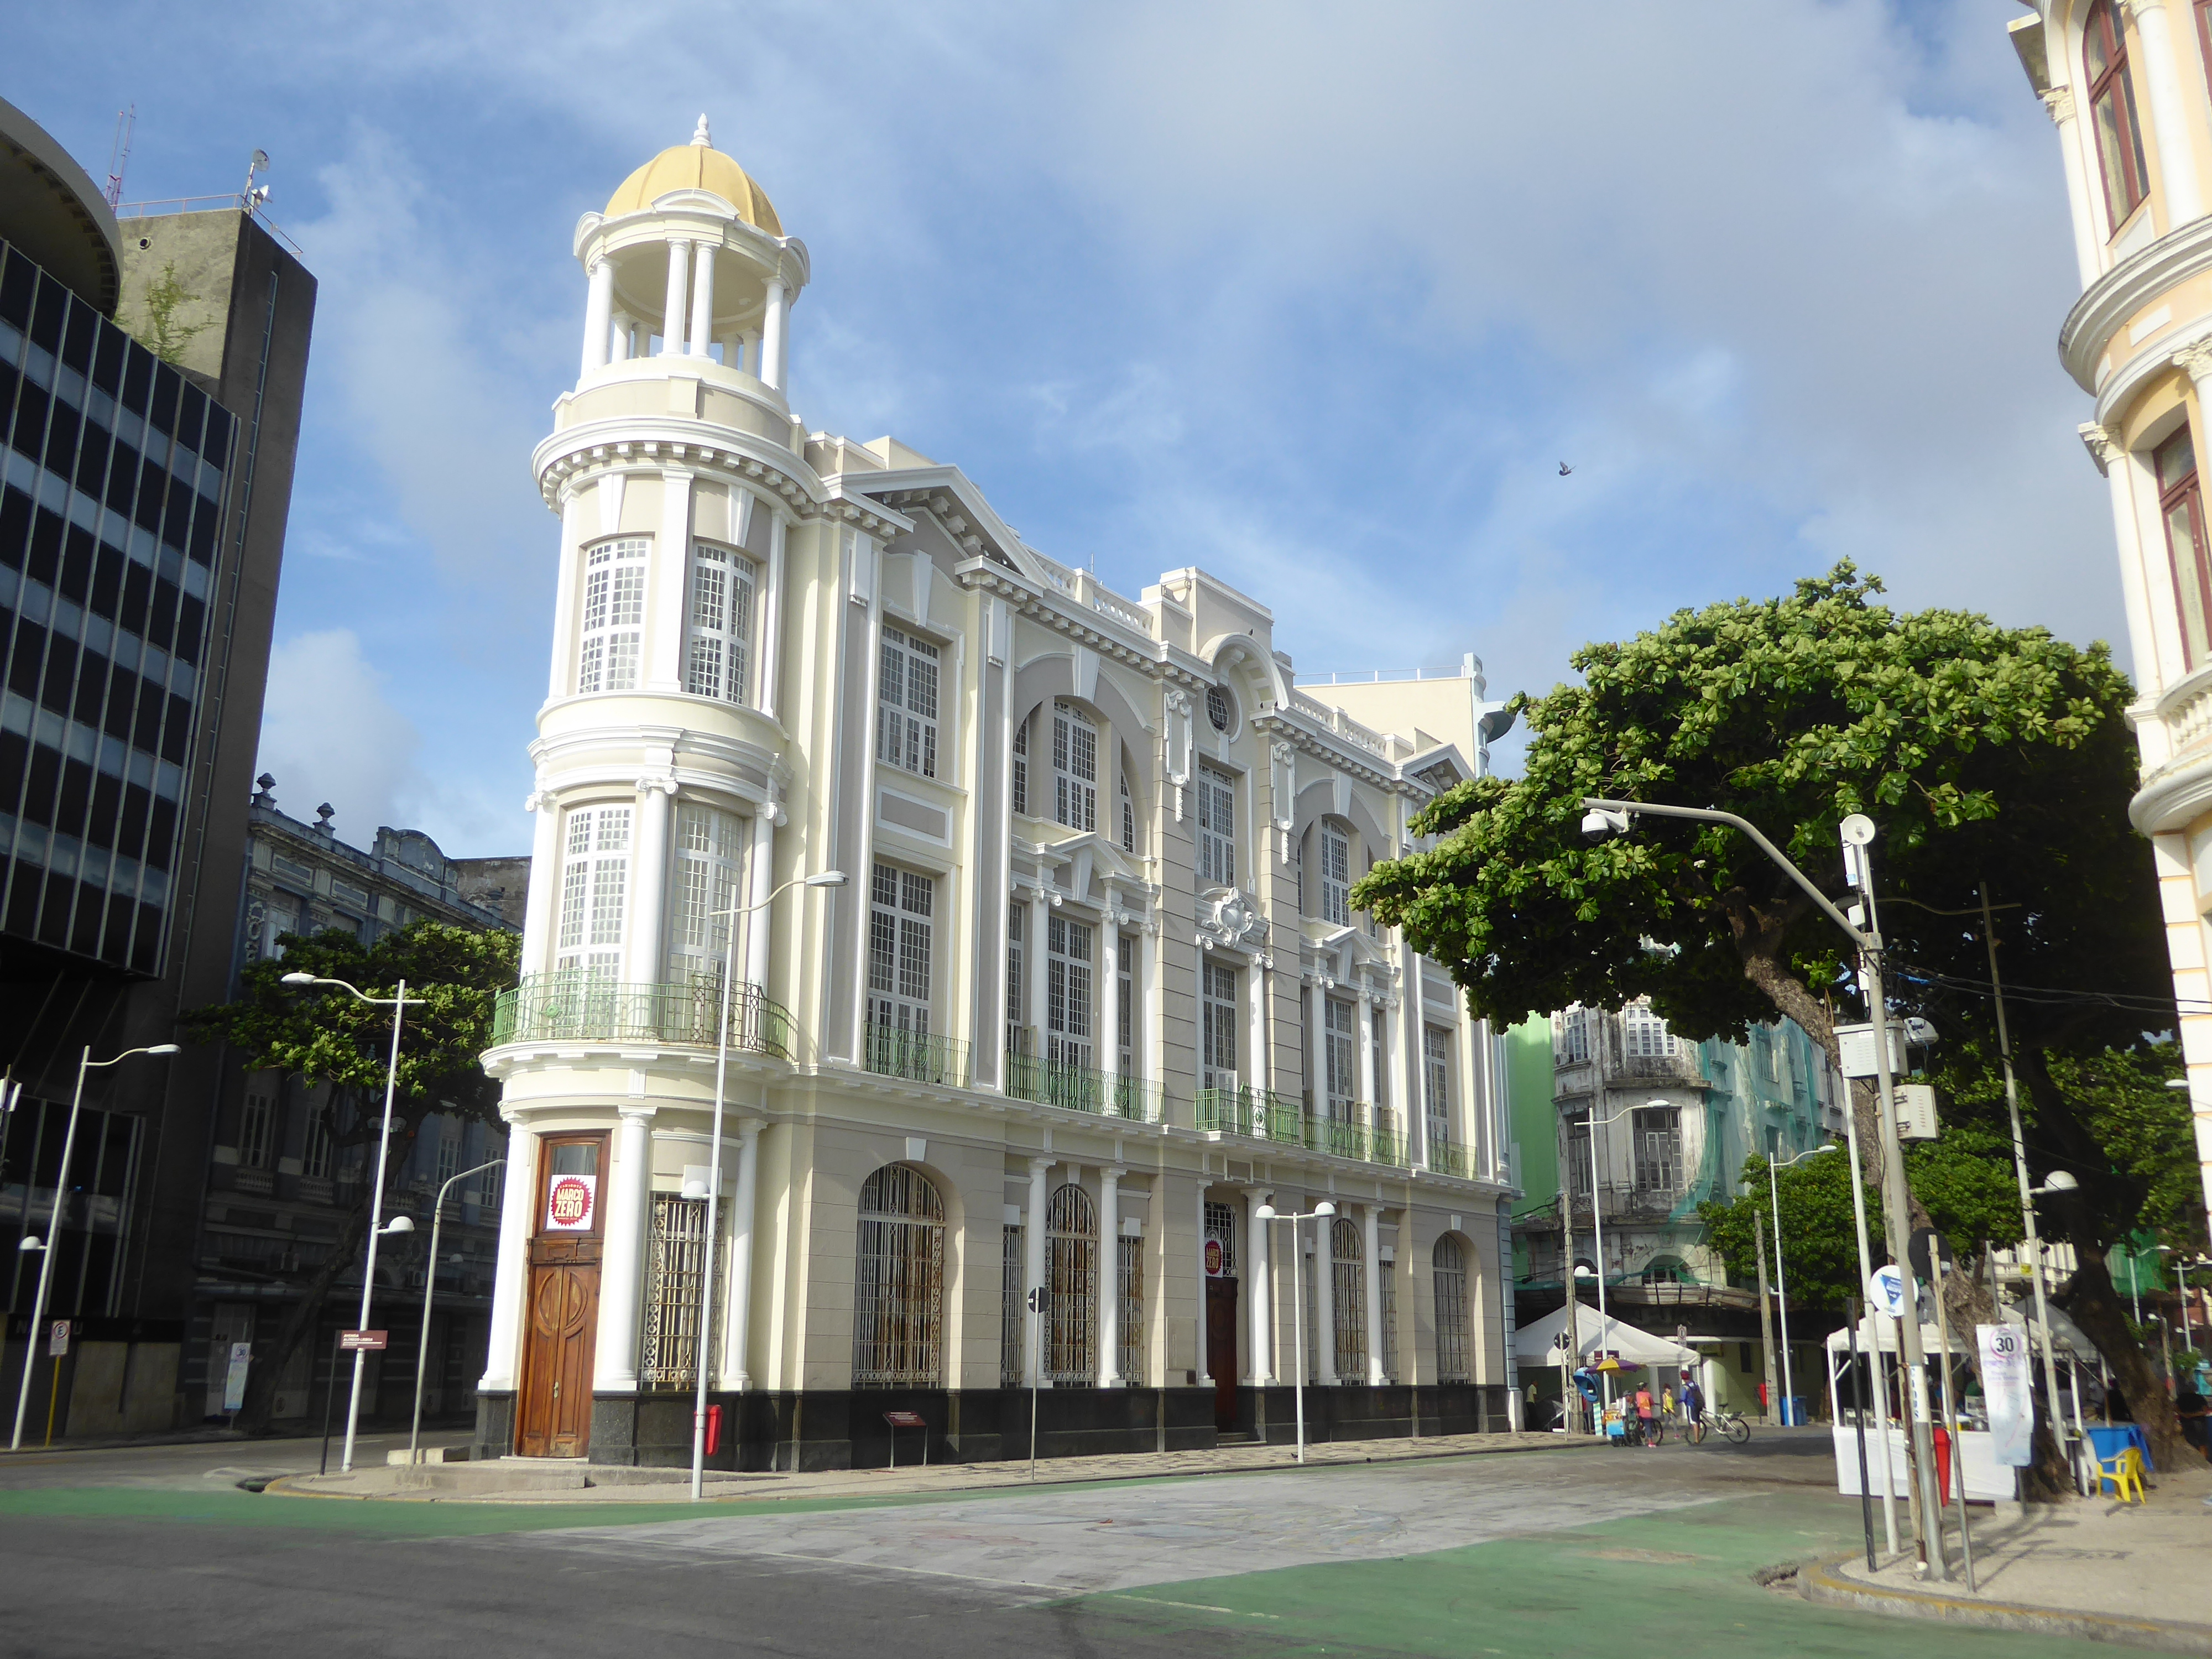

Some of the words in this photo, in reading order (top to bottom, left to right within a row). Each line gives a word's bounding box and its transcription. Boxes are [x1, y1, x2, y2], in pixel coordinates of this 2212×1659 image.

[556, 1188, 585, 1201] MARCO
[554, 1201, 583, 1217] ZERO
[1206, 1256, 1219, 1269] ZERO
[1995, 1337, 2013, 1353] 30
